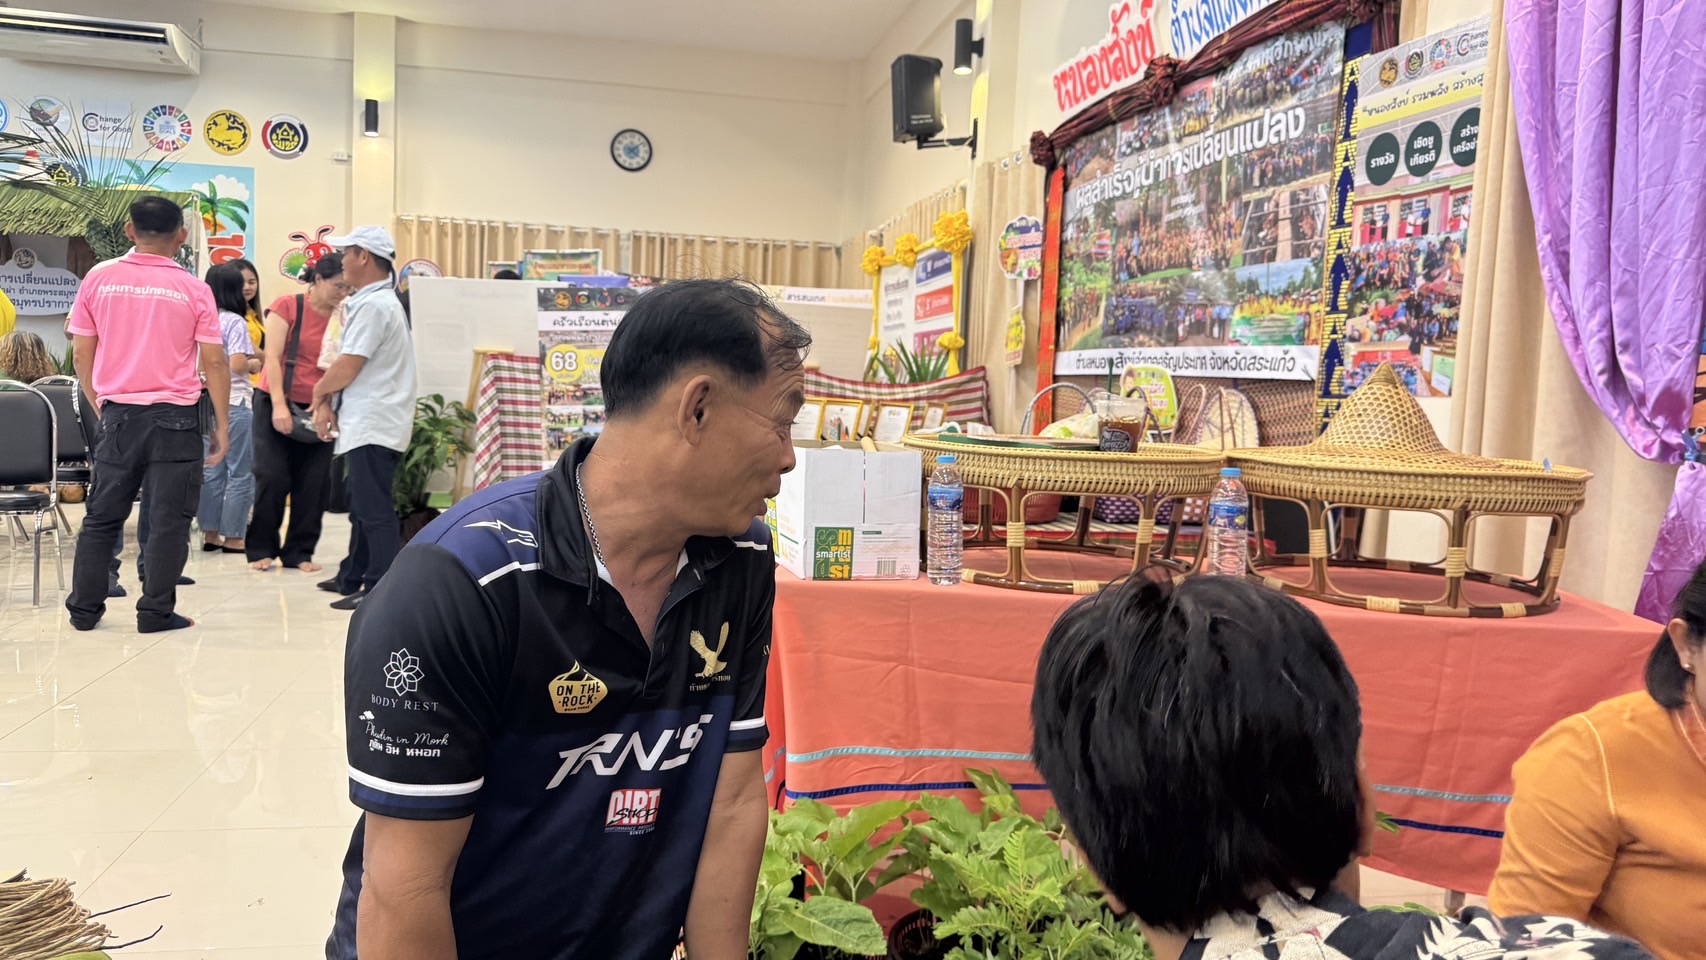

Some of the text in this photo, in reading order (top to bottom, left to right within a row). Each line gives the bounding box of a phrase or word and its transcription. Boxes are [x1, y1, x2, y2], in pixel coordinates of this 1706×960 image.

[1414, 135, 1434, 149] เชิดชู
[1370, 152, 1395, 168] รางวัล
[1410, 149, 1436, 166] เกียรติ
[0, 271, 76, 286] ารเปลี่ยนแปลง
[552, 312, 620, 327] ครัวเรือนต้น
[550, 351, 578, 372] 68
[1209, 349, 1296, 372] จังหวัดสระแก้ว
[815, 549, 851, 558] smartist
[556, 681, 601, 696] ON THE
[371, 693, 439, 711] BODY REST
[396, 735, 409, 744] in
[405, 747, 441, 758] หมอก
[607, 789, 661, 825] DIRT
